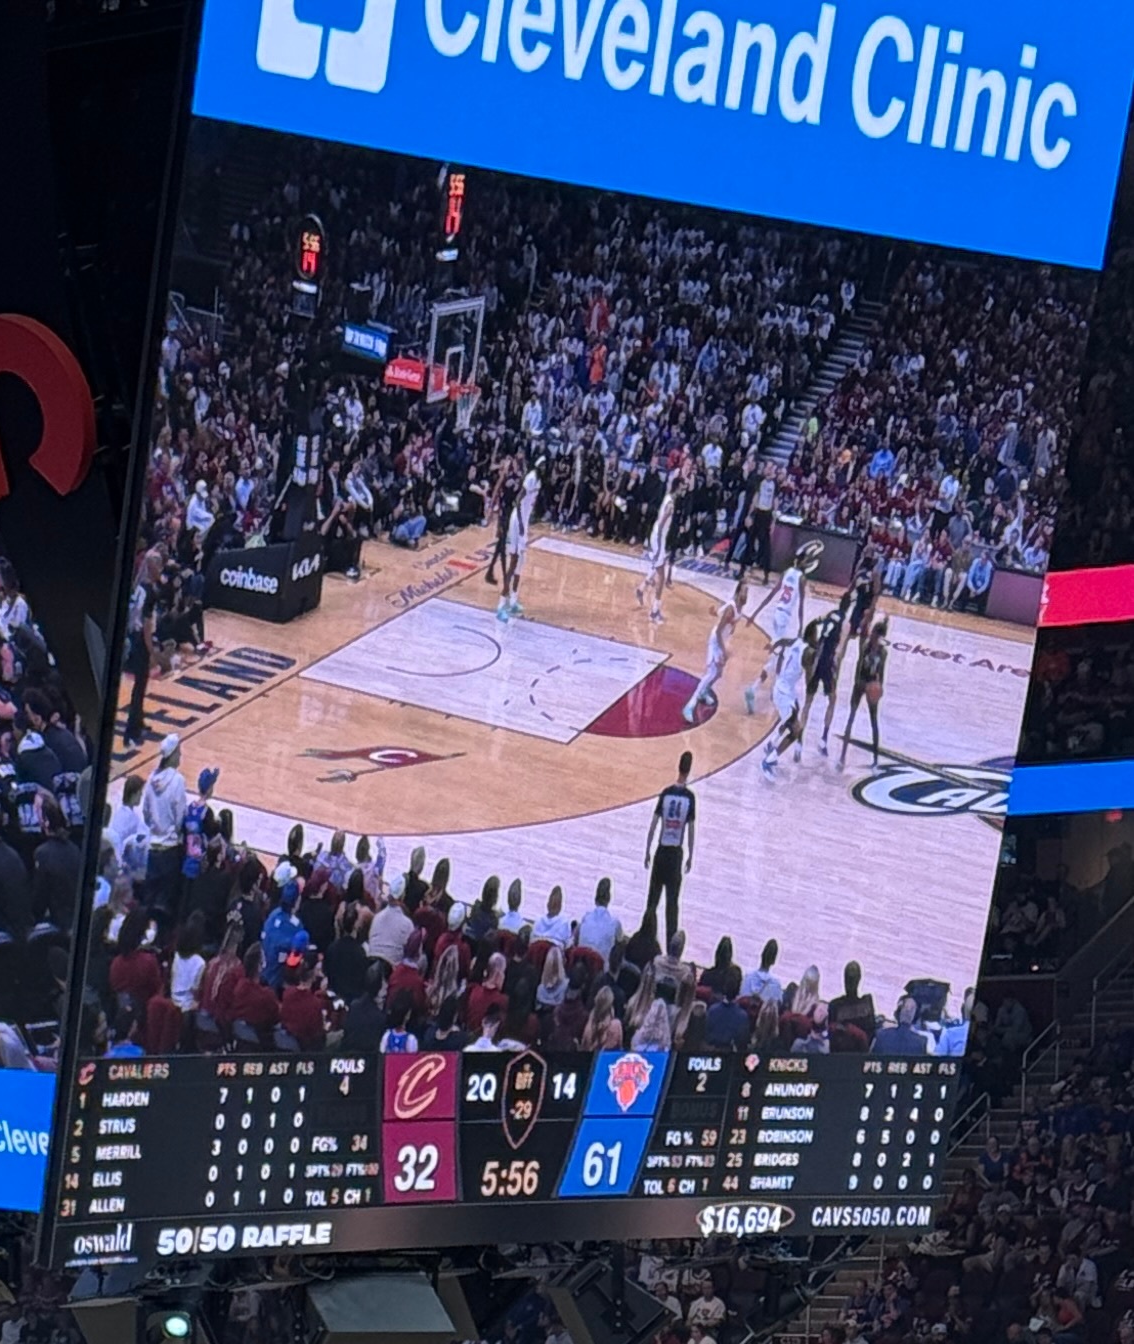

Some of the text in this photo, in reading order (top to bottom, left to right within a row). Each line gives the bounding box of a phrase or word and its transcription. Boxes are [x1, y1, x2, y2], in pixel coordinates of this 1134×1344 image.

[424, 0, 1078, 170] Cleveland Clinic
[219, 567, 279, 594] coinbase
[108, 1063, 169, 1080] CAVALIERS
[217, 1063, 237, 1076] PTS
[269, 1062, 290, 1075] AST
[330, 1059, 365, 1074] FOULS
[687, 1057, 722, 1071] FOULS
[768, 1058, 809, 1073] KNICKS
[912, 1062, 933, 1075] AST
[339, 1076, 350, 1095] 4
[466, 1073, 497, 1101] 2Q
[552, 1073, 577, 1099] 14
[696, 1073, 708, 1092] 2
[764, 1083, 923, 1099] ANUNOBY 7 2
[102, 1092, 149, 1107] HARDEN
[737, 1106, 749, 1120] 11
[761, 1106, 814, 1120] BRUNSON
[860, 1106, 870, 1121] 8
[884, 1106, 894, 1121] 2
[909, 1107, 919, 1122] 4
[934, 1107, 944, 1122] 0
[73, 1118, 136, 1136] 2 STRUS
[701, 1129, 718, 1146] 59
[729, 1129, 940, 1145] 23 ROBINSON 6 5 0 0
[71, 1144, 141, 1163] 5 MERRILL
[726, 1152, 911, 1167] 25 BRIDGES 8 0 2
[394, 1145, 438, 1191] 32
[582, 1141, 622, 1186] 61
[92, 1171, 122, 1187] ELLIS
[480, 1160, 540, 1196] 5:56
[722, 1174, 932, 1190] 44 SHAMET 9 0 0 0
[643, 1180, 696, 1195] TOL CH
[88, 1198, 125, 1213] ALLEN
[305, 1189, 361, 1206] TOL CH
[701, 1205, 783, 1238] $16,694
[811, 1206, 932, 1227] CAVS5050.COM
[74, 1223, 133, 1254] oswald
[241, 1222, 332, 1249] RAFFLE
